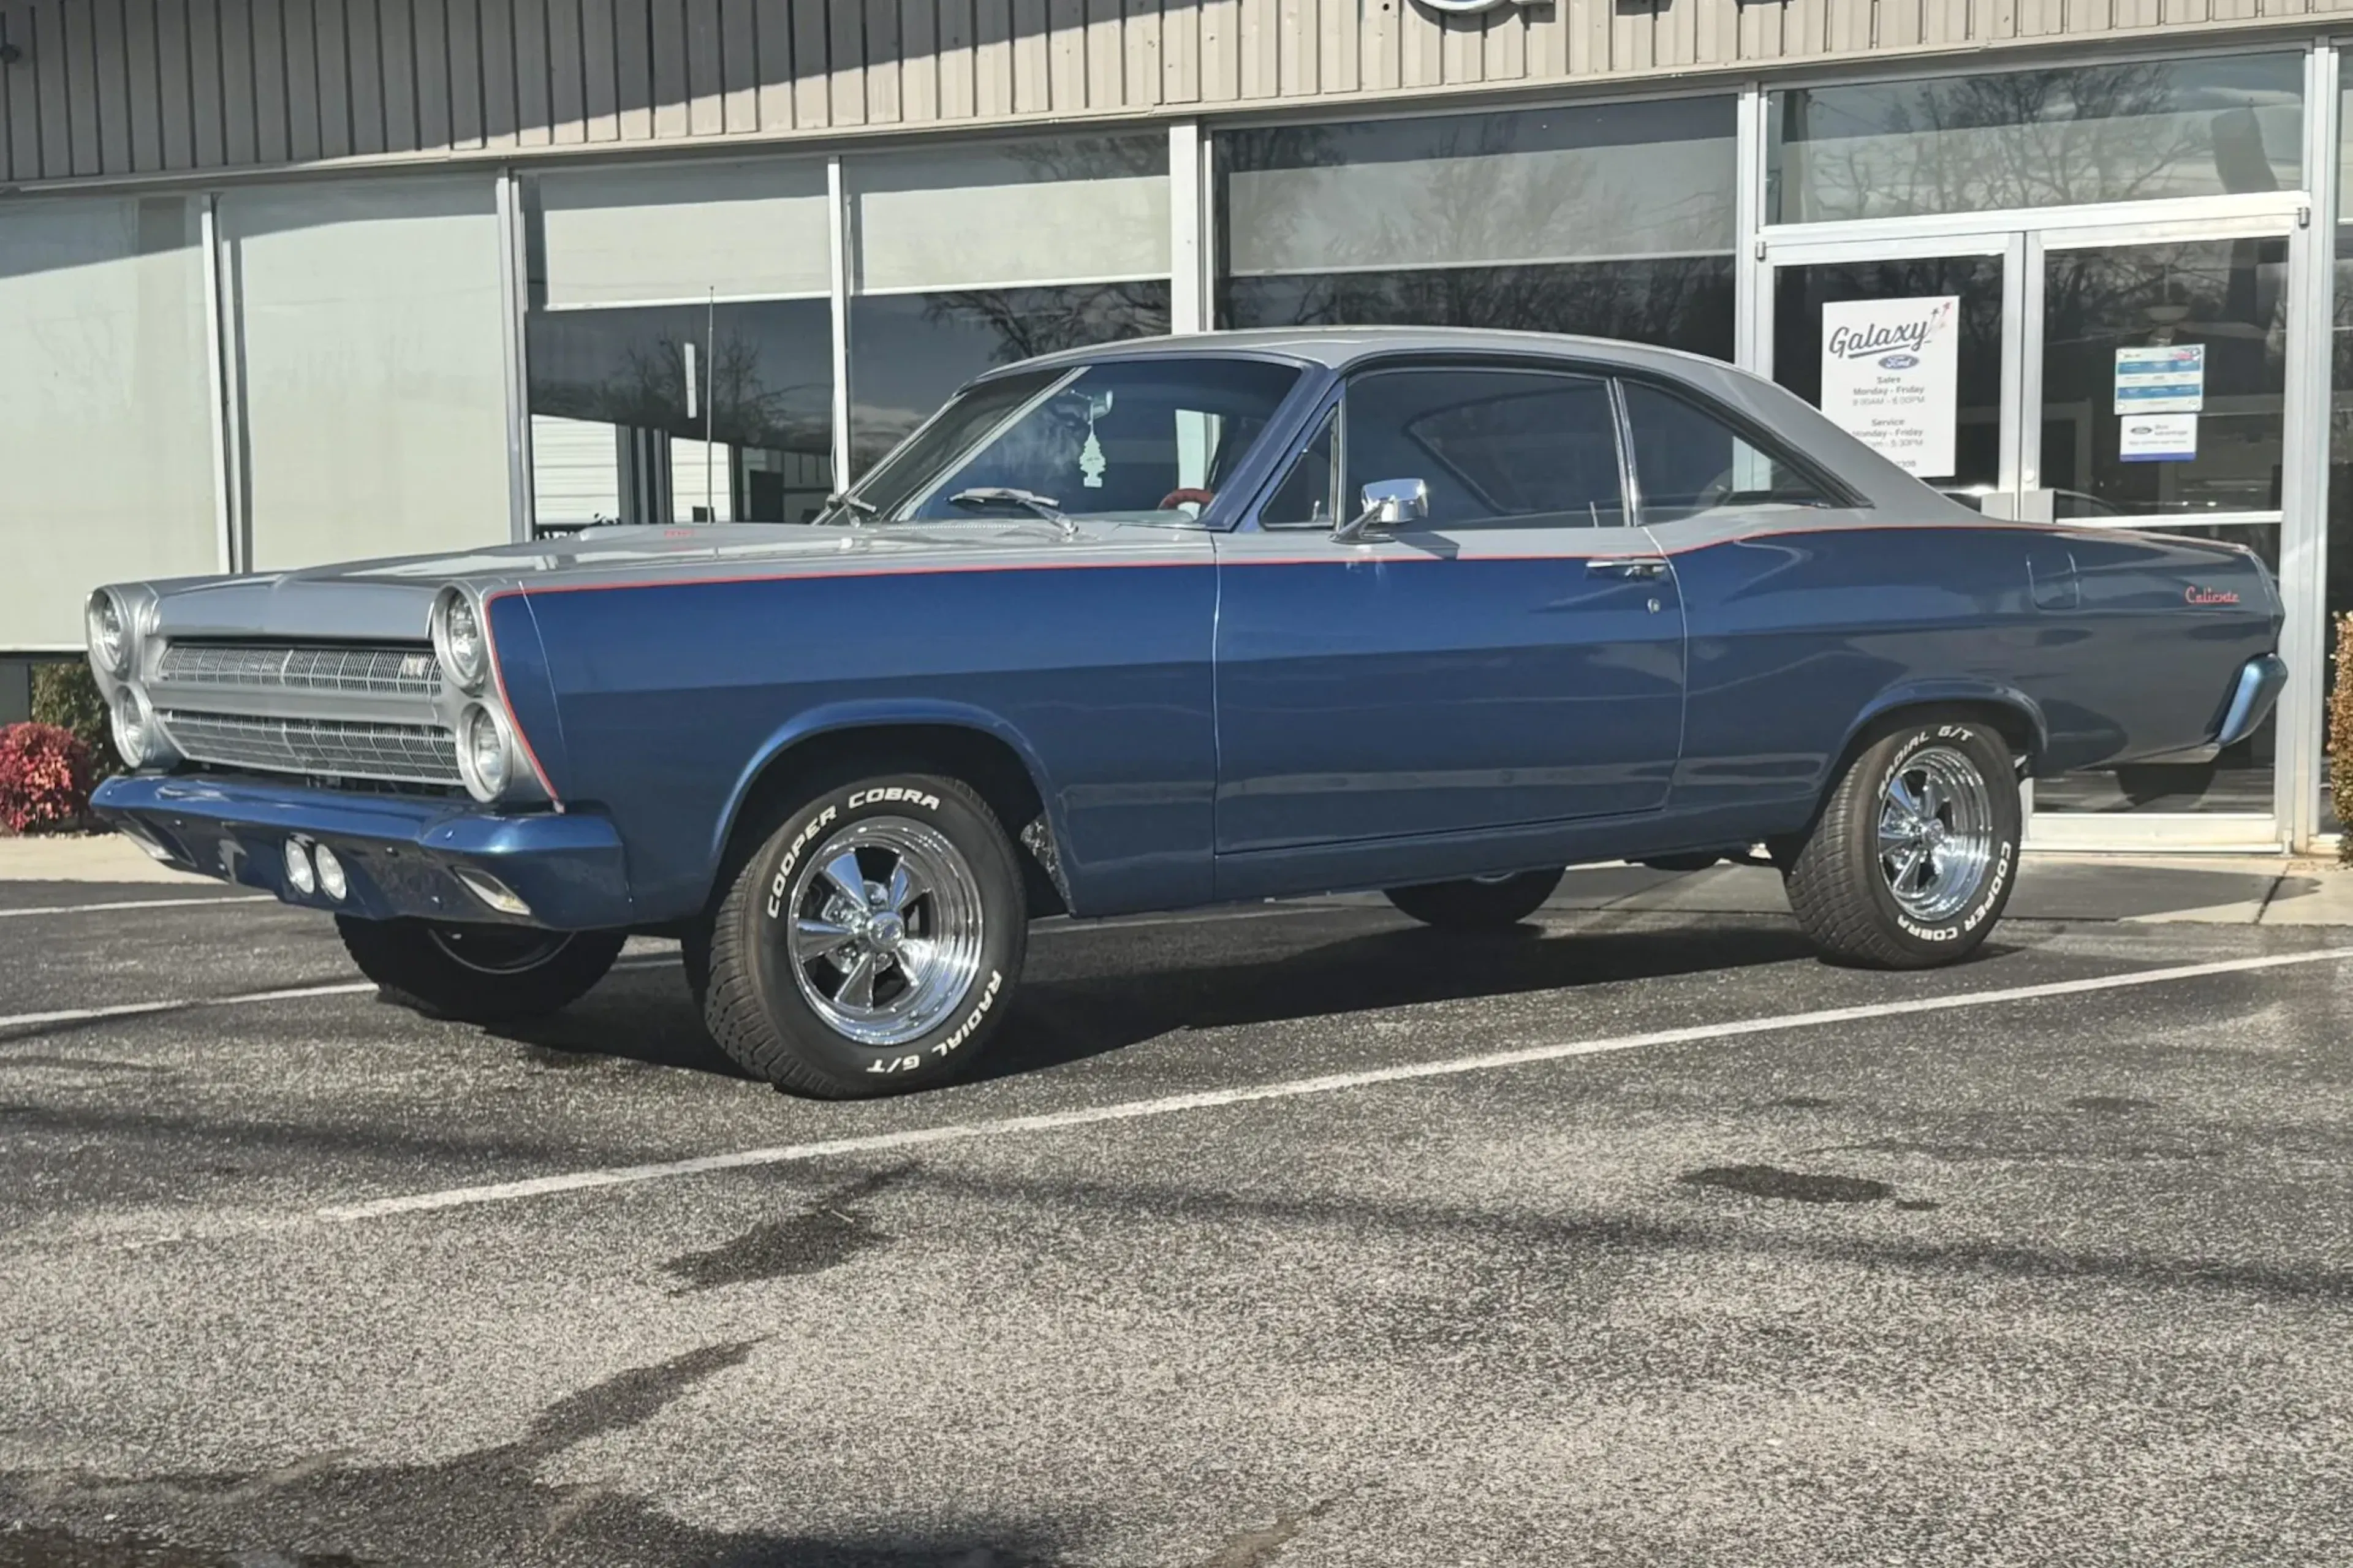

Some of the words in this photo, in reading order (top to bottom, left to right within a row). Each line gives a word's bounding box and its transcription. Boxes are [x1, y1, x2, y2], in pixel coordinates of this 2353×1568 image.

[1829, 320, 1928, 358] Galaxy
[1853, 387, 1888, 396] Monday
[1896, 386, 1925, 395] Friday
[2185, 586, 2240, 604] Caliente
[1878, 731, 1930, 800] RADIAL
[1938, 725, 1974, 741] G/T
[767, 805, 837, 918] COOPER
[849, 787, 940, 811] COBRA
[1964, 841, 2011, 931] COOPER
[1897, 914, 1958, 941] COBRA
[931, 970, 1002, 1056] RADIAL
[866, 1054, 920, 1073] G/T
